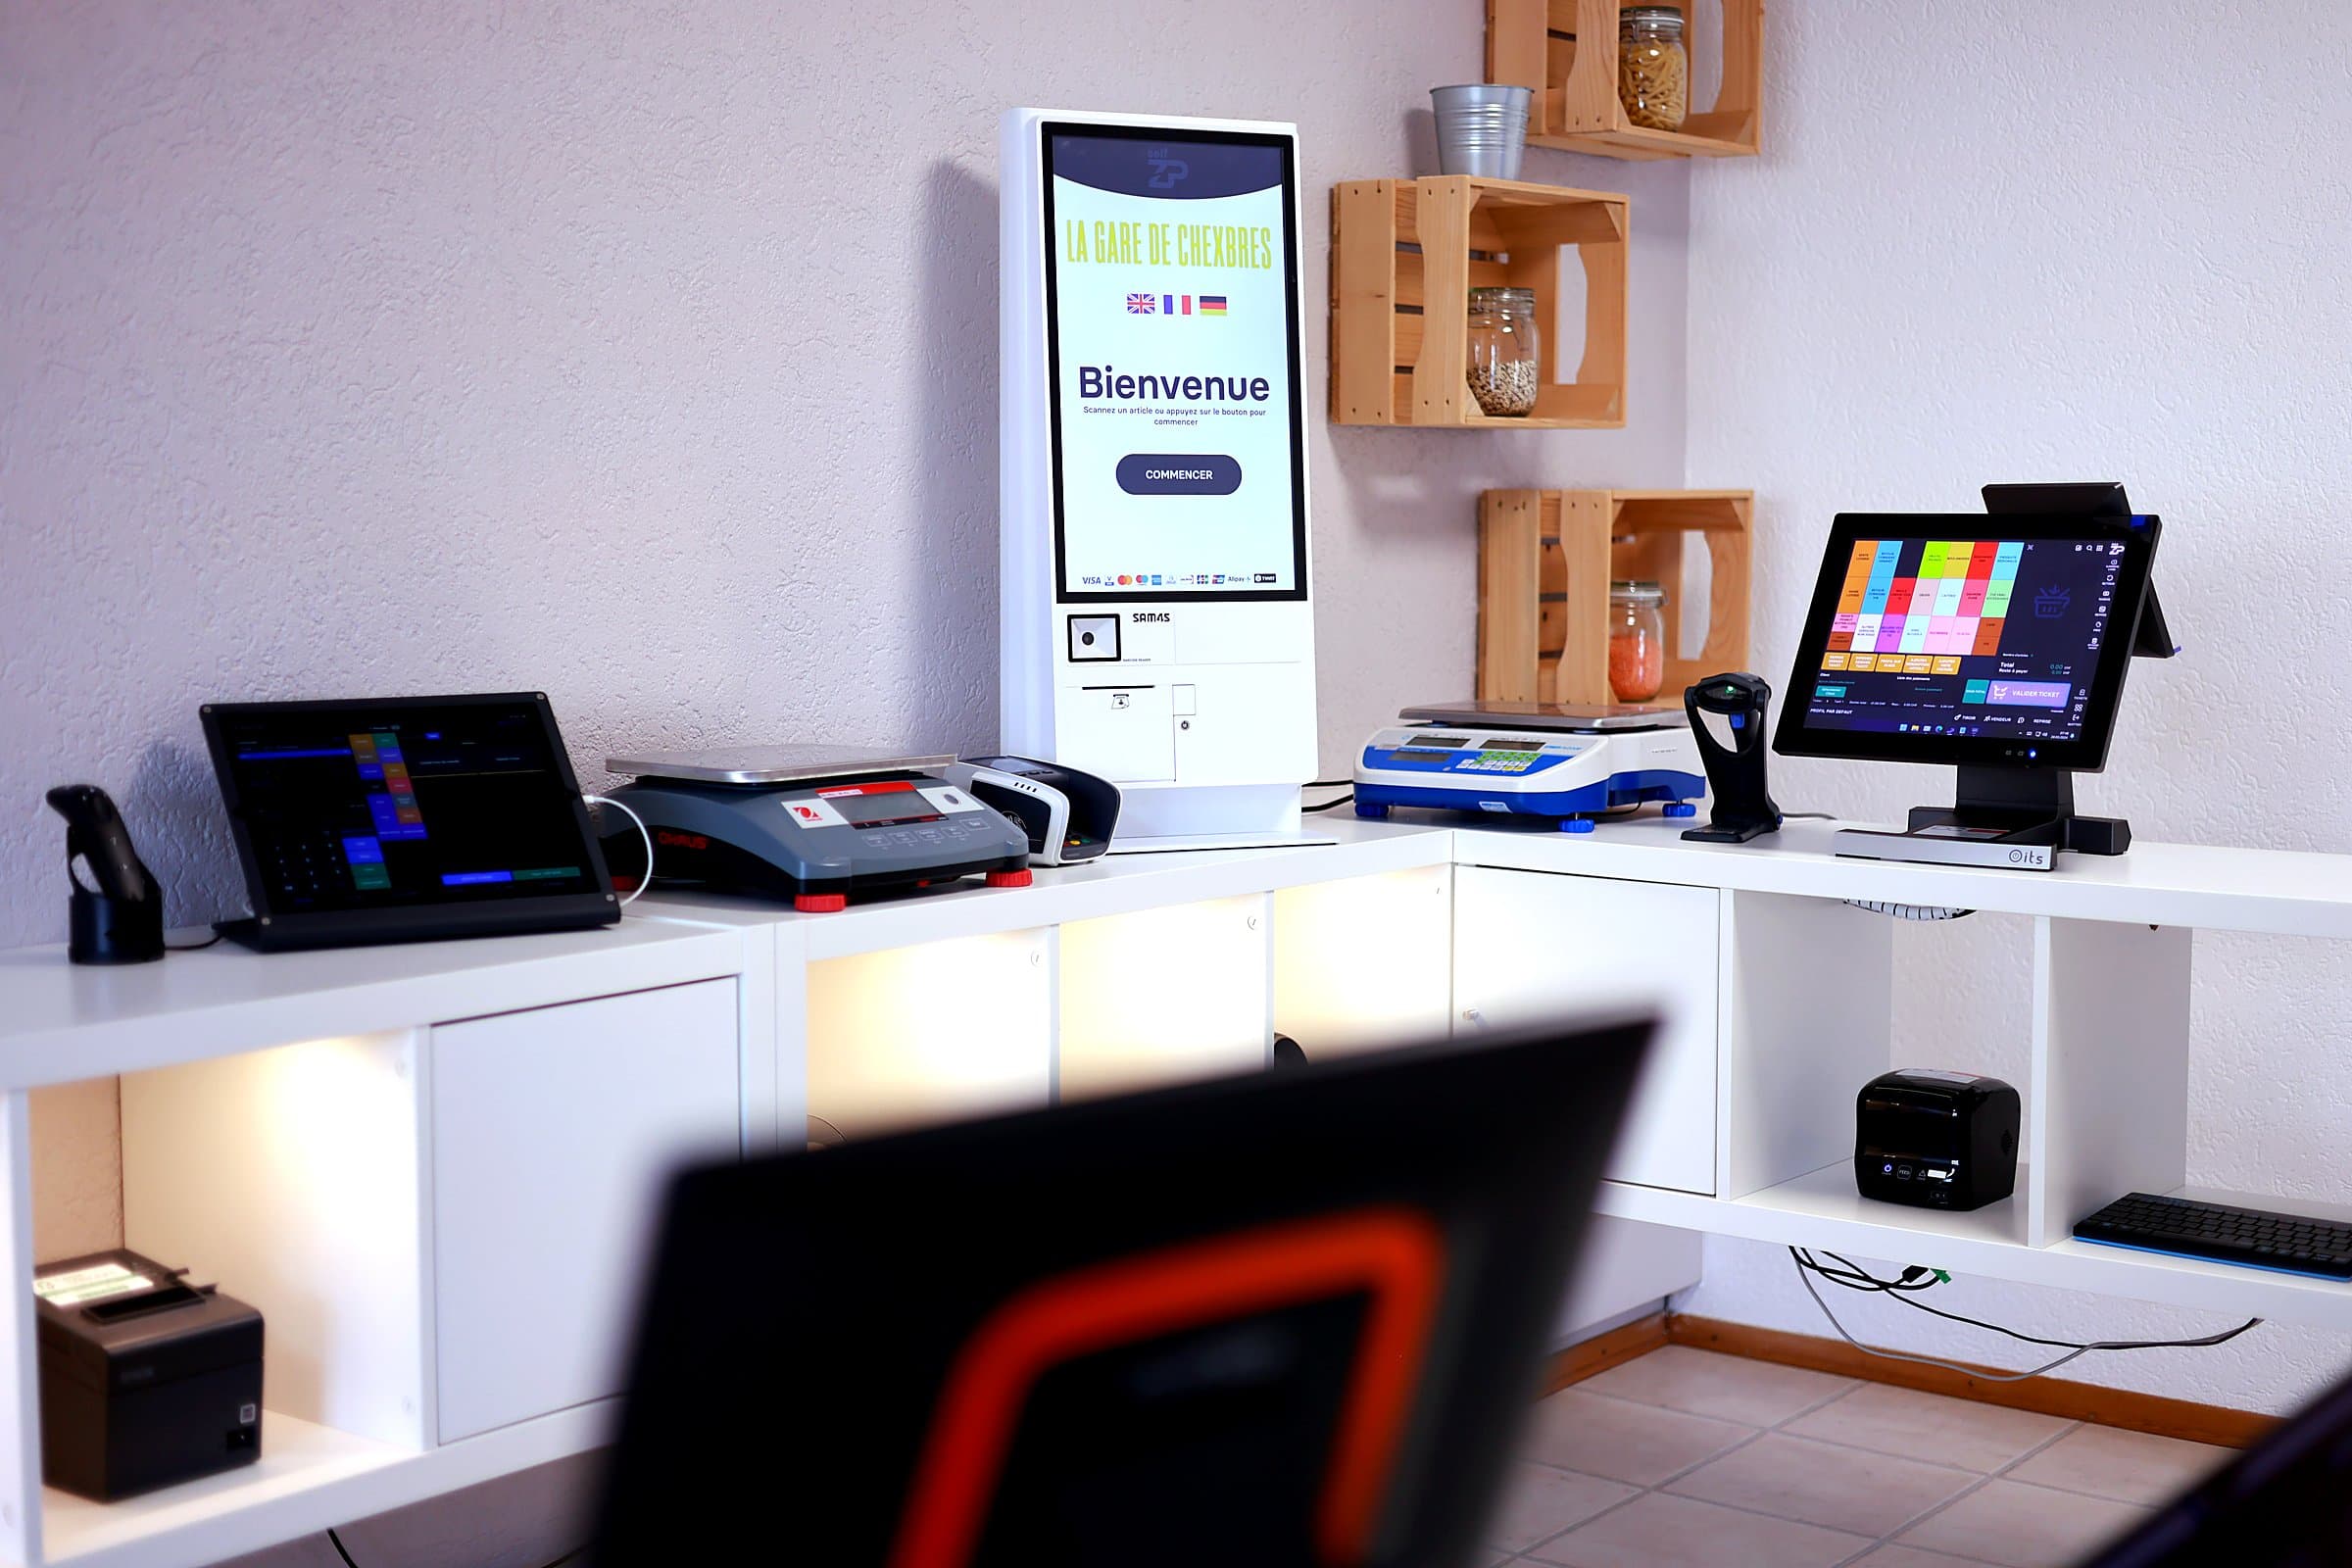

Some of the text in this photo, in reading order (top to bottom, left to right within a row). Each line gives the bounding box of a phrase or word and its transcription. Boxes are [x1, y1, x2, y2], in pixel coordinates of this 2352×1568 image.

[1066, 220, 1272, 270] LA GARE DE CHEXBRES
[1079, 365, 1270, 402] Bienvenue
[1145, 469, 1213, 480] COMMENCER
[1082, 576, 1102, 585] VISA
[2012, 689, 2038, 698] VALIDER
